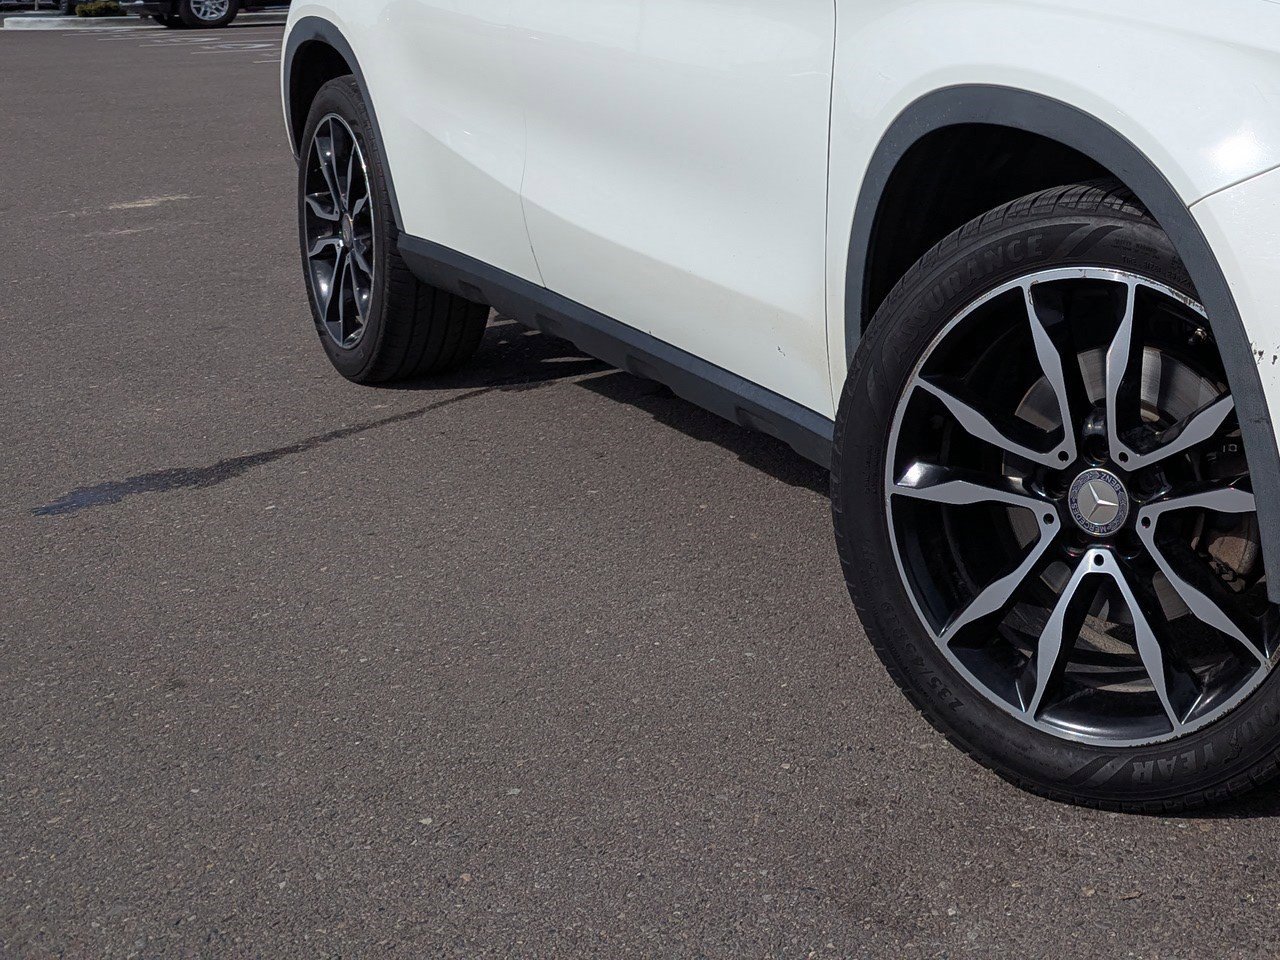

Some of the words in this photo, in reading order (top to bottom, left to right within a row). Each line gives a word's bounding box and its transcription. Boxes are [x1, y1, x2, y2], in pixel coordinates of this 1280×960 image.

[891, 233, 1044, 362] ASSURANCE
[1101, 472, 1121, 491] BENZ
[1071, 503, 1107, 533] MERCEDES
